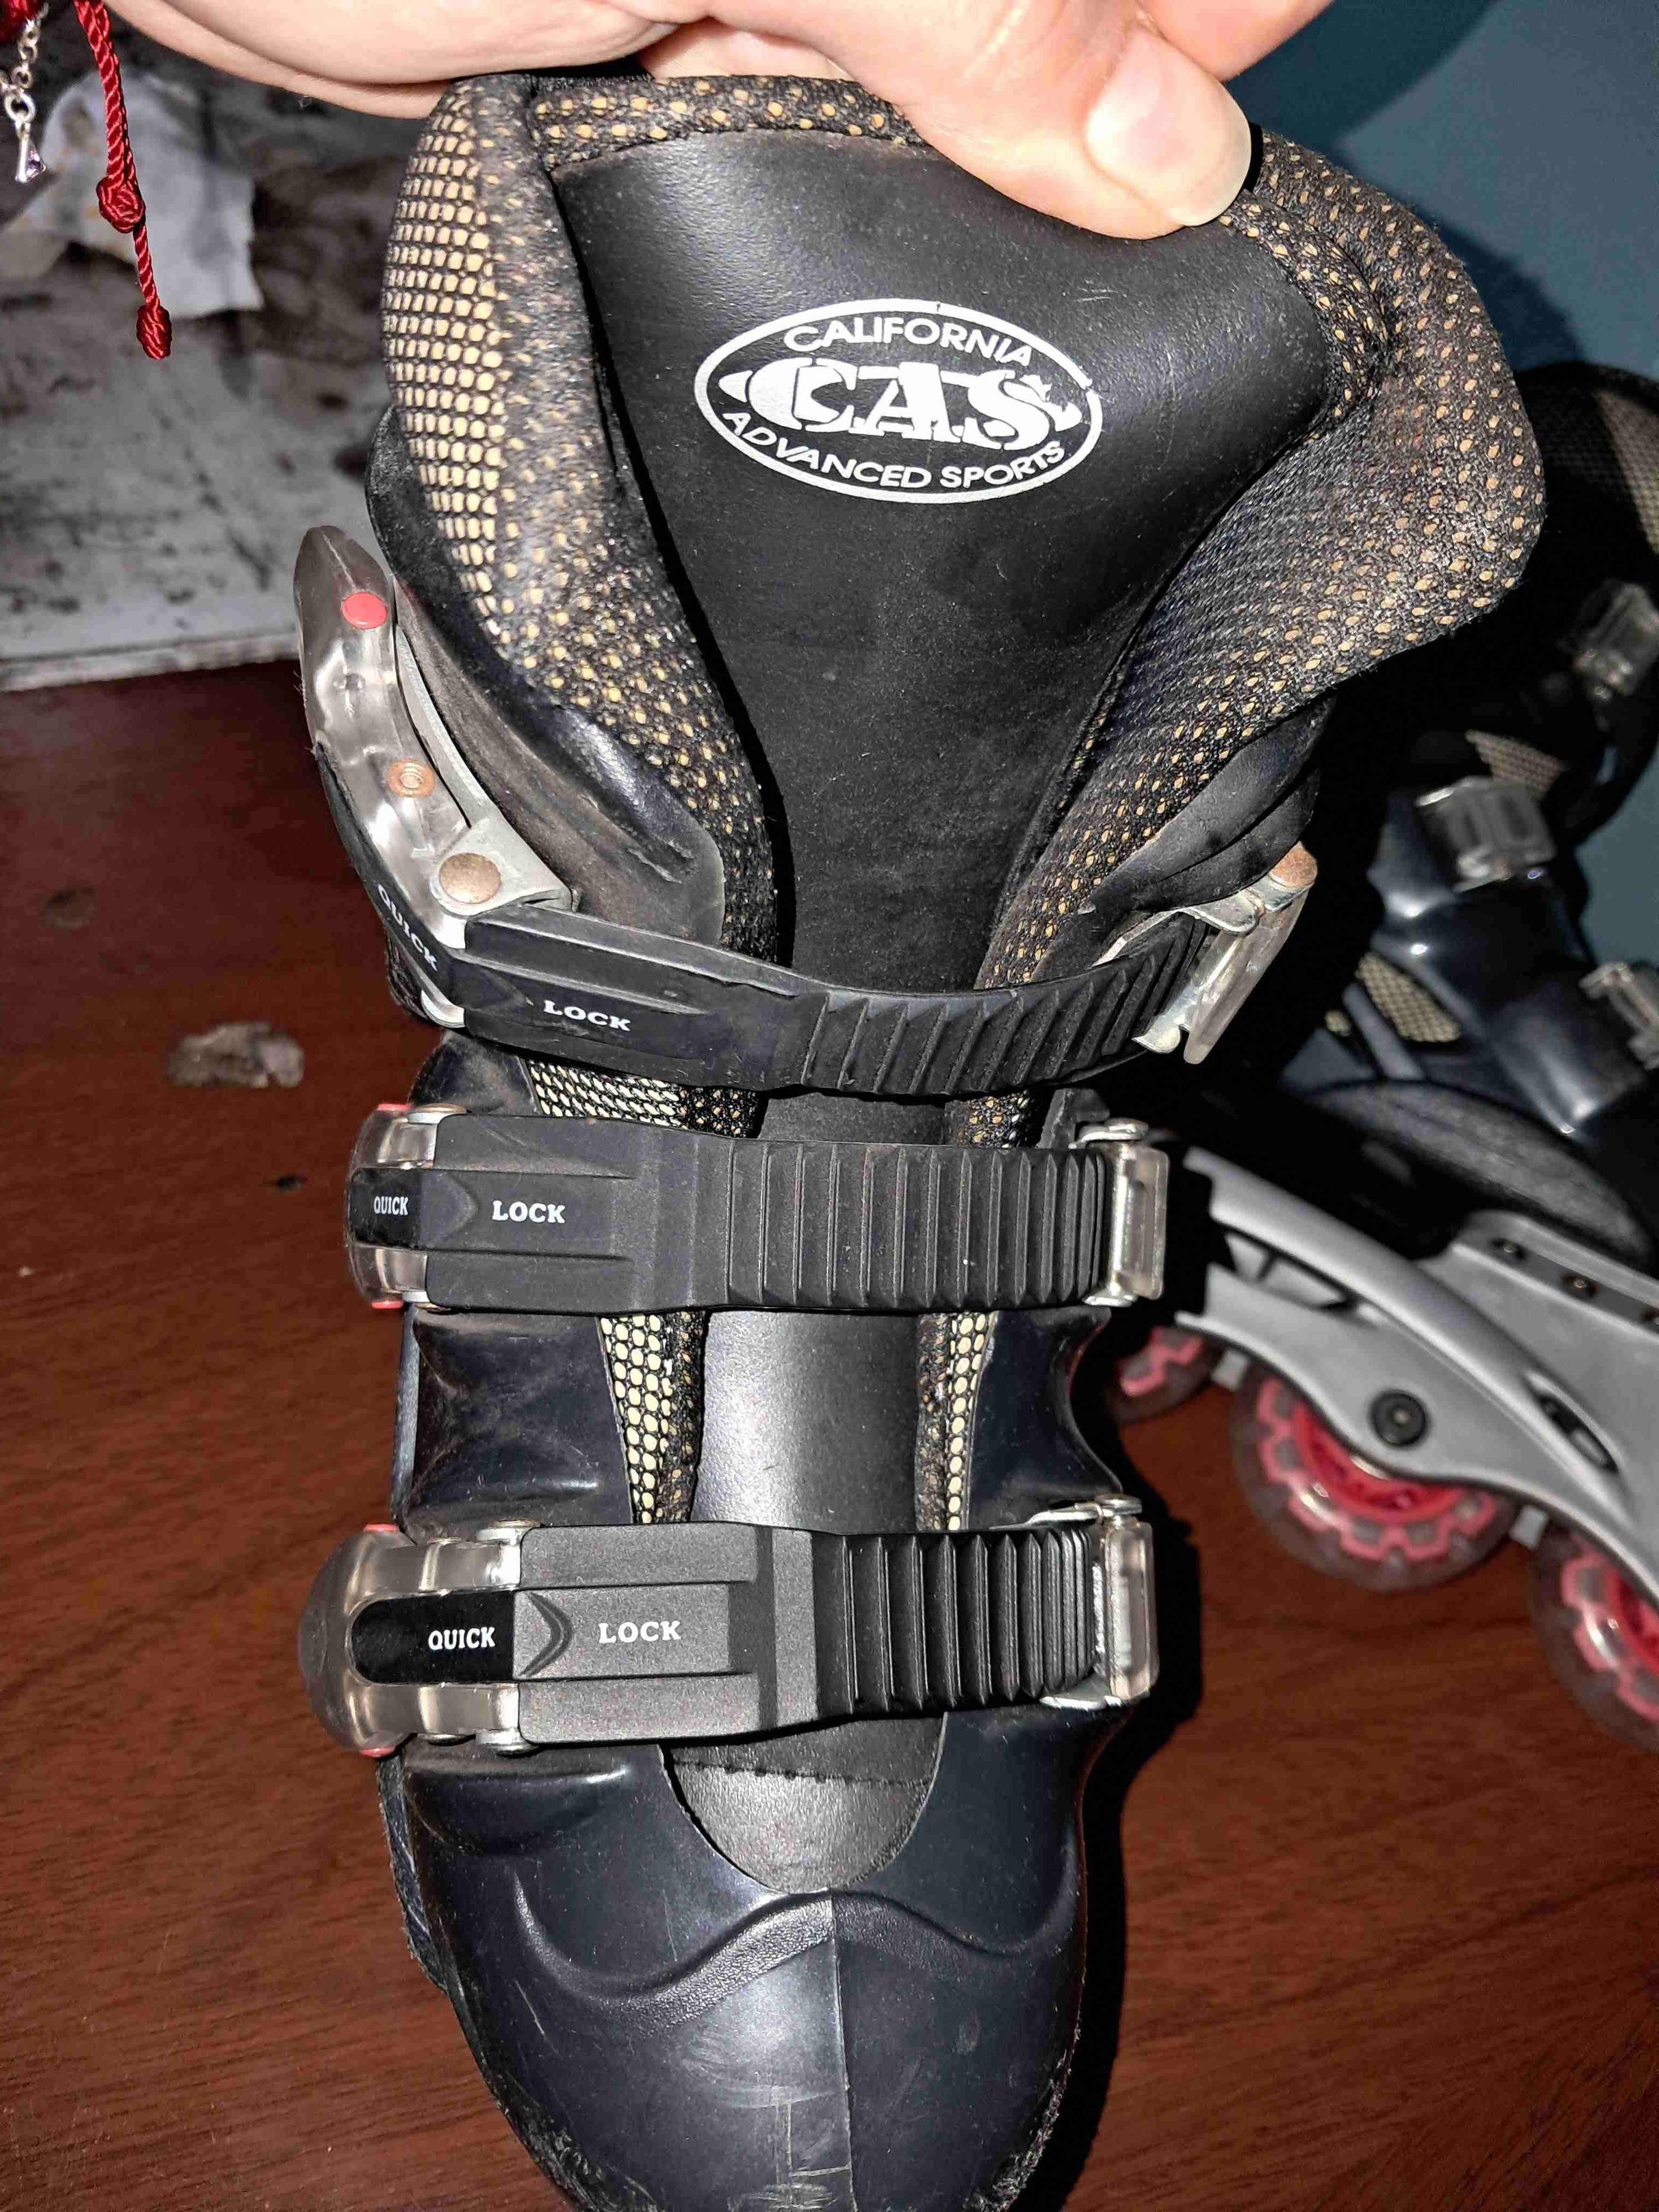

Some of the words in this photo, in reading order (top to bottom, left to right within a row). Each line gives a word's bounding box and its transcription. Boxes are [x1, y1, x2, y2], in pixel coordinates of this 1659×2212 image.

[783, 317, 1033, 367] CALIFORNIA
[748, 357, 1083, 451] CAS
[722, 410, 932, 488] ADVANCED
[940, 440, 1066, 489] SPORTS
[377, 884, 438, 972] QUICK
[543, 999, 631, 1032] LOCK
[373, 1195, 409, 1216] QUICK
[491, 1200, 566, 1224] LOCK
[427, 1626, 496, 1651] QUICK
[597, 1619, 683, 1645] LOCK
